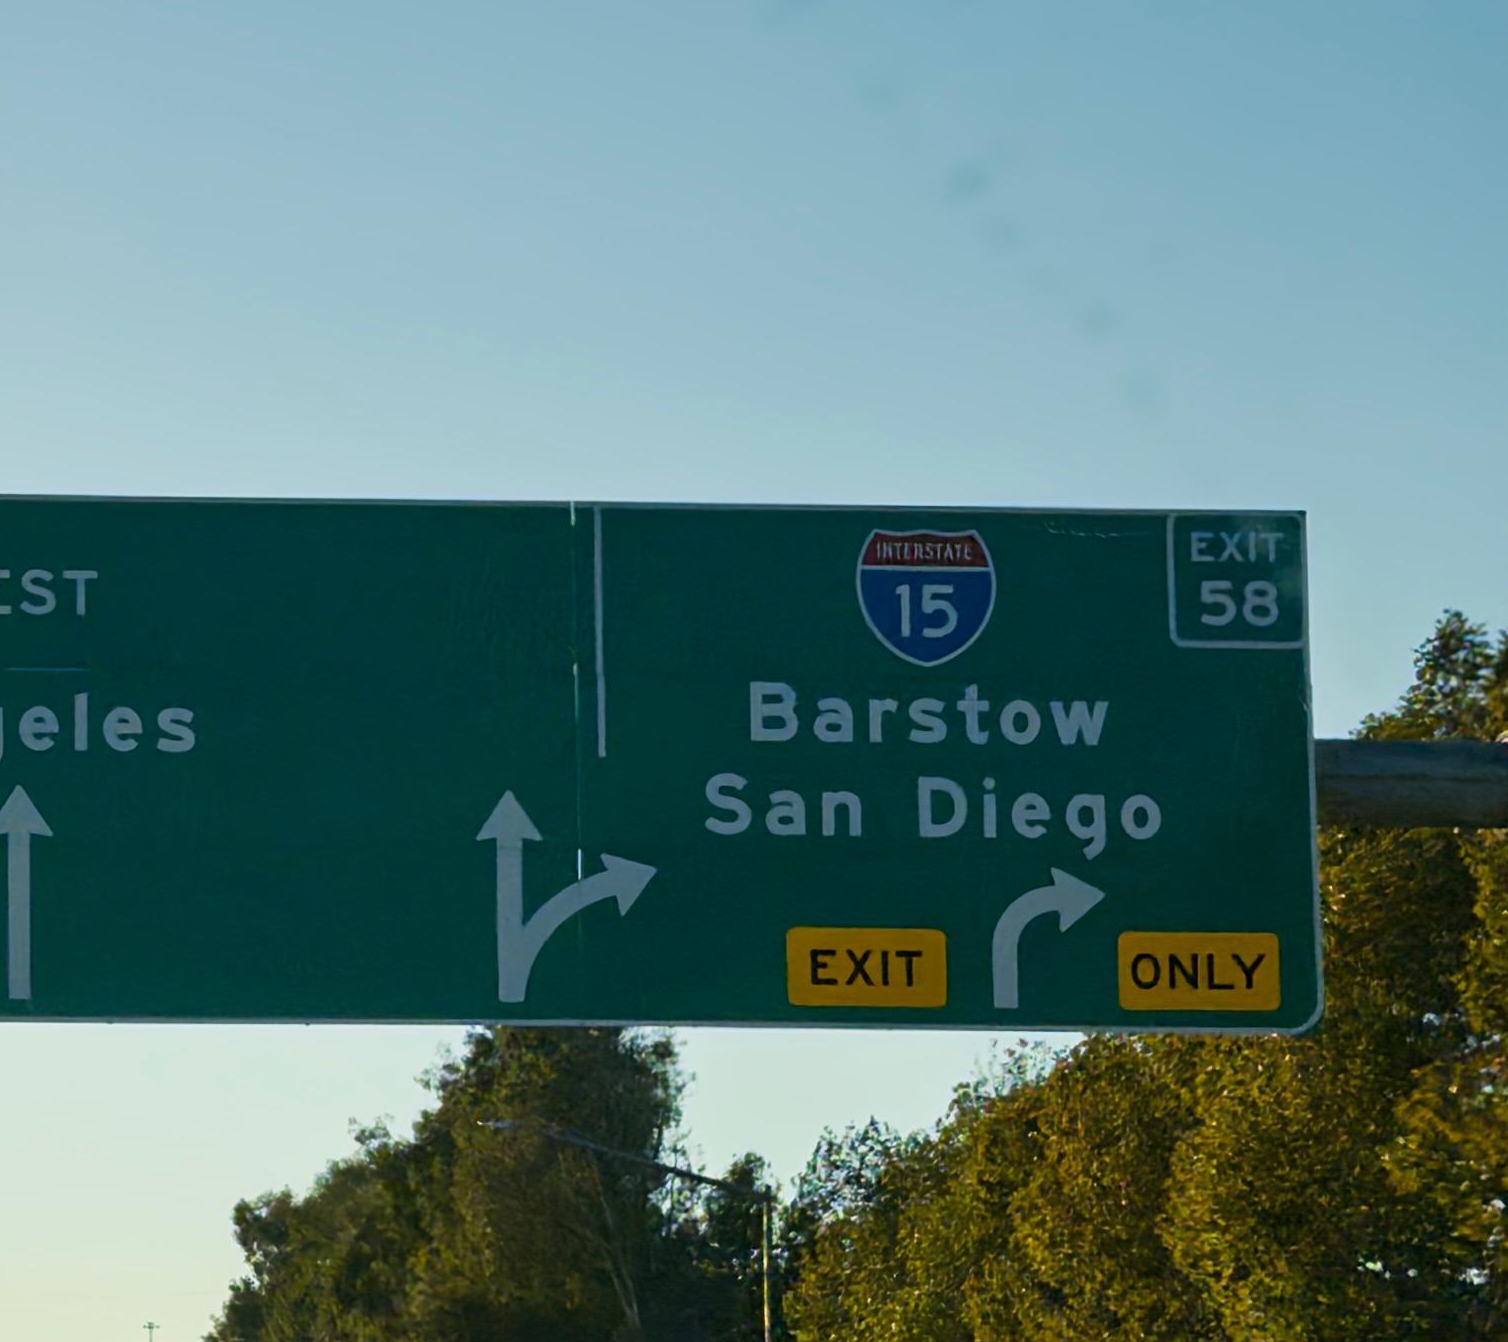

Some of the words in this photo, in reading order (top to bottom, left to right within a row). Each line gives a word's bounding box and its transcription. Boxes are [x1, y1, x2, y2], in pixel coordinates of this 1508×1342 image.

[876, 541, 973, 561] INTERSTATE
[1191, 531, 1283, 563] EXIT
[895, 583, 958, 638] 15
[1200, 580, 1280, 627] 58
[750, 681, 1109, 746] Barstow
[704, 772, 861, 837] San
[917, 775, 1162, 860] Diego
[809, 948, 923, 987] EXIT
[1129, 953, 1266, 991] ONLY
